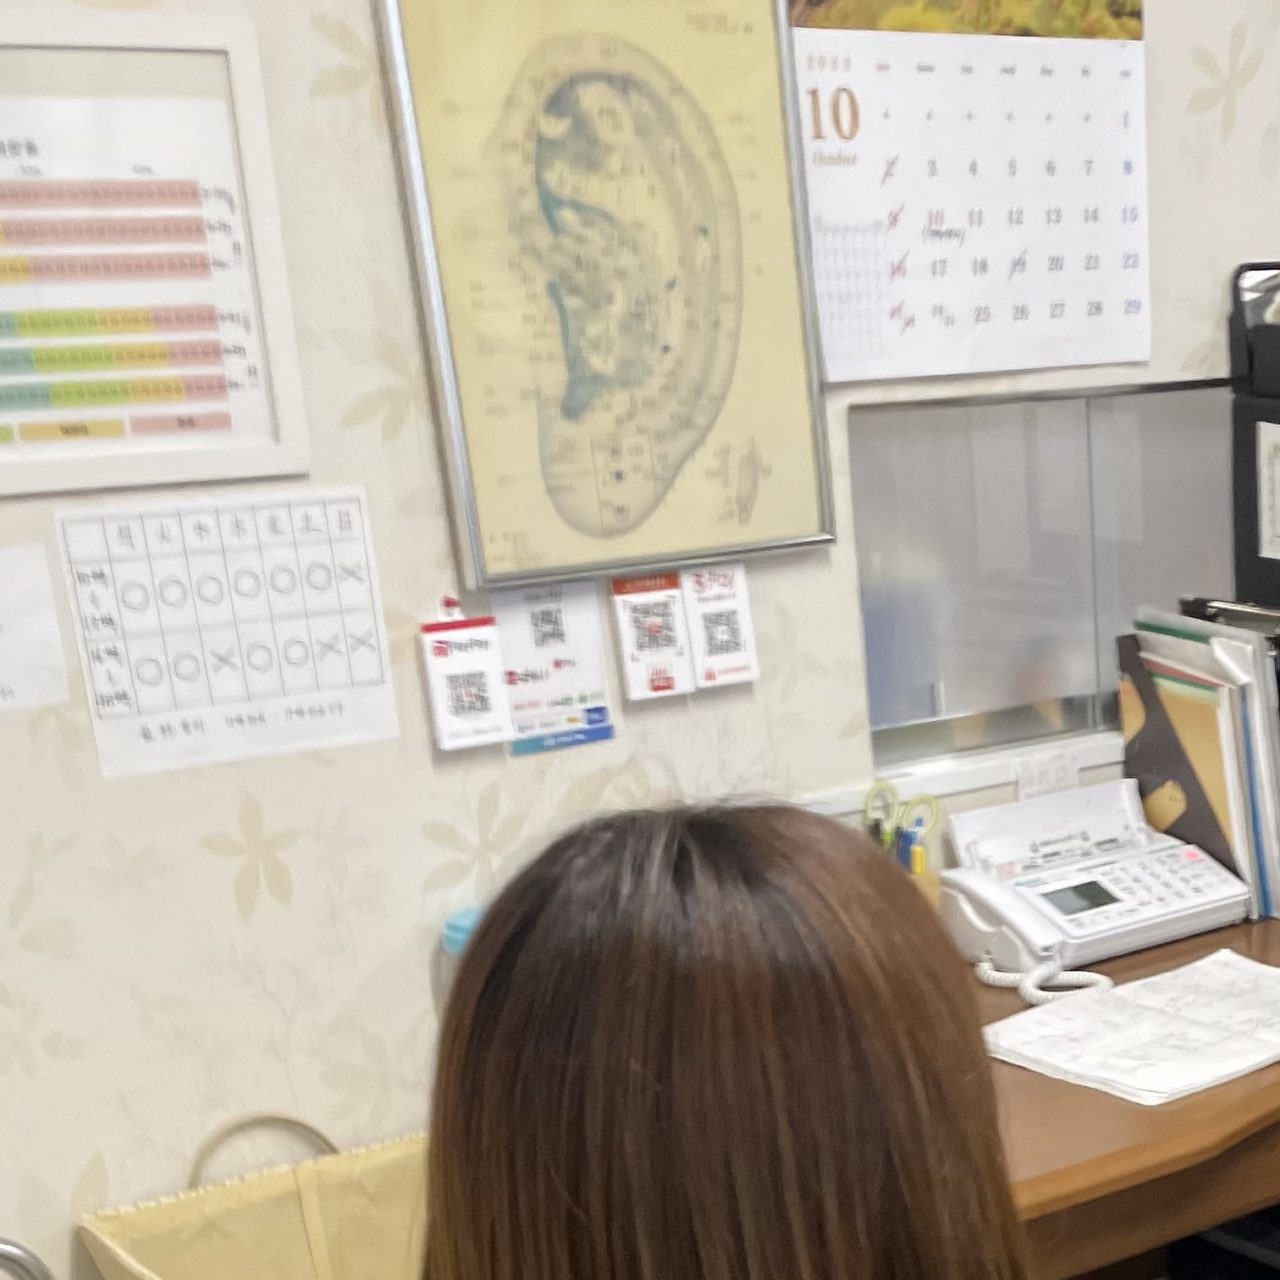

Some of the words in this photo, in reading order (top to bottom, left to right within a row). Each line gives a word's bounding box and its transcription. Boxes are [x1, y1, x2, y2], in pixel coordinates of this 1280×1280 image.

[806, 86, 861, 142] 10
[1085, 158, 1095, 177] 7
[968, 208, 984, 228] 11
[1008, 207, 1024, 226] 12
[1046, 207, 1062, 225] 13
[1084, 206, 1100, 224] 14
[1122, 205, 1139, 224] 15
[932, 259, 948, 277] 17
[972, 258, 989, 276] 18
[1048, 254, 1065, 273] 20
[1084, 253, 1100, 271] 21
[1122, 252, 1140, 270] 22
[974, 304, 992, 323] 25
[1012, 303, 1029, 321] 26
[1050, 300, 1066, 320] 27
[1087, 299, 1104, 317] 28
[1124, 297, 1142, 315] 29
